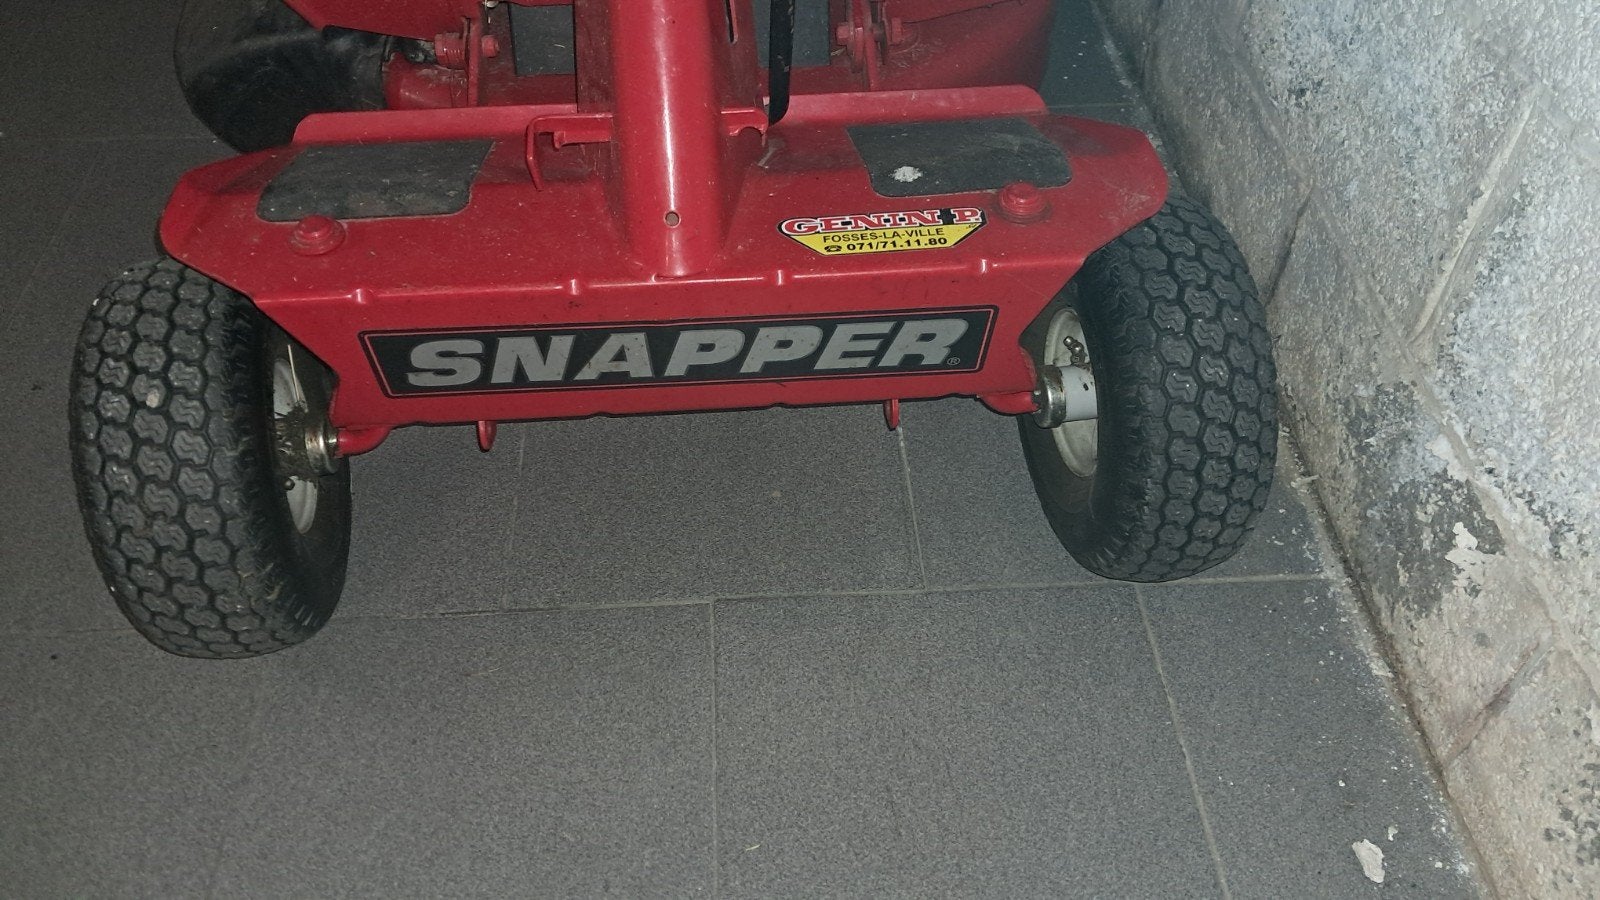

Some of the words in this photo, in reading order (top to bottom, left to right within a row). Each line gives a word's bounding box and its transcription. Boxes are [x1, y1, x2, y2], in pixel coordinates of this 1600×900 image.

[781, 209, 943, 236] GENIN
[823, 228, 945, 243] FOSSES-LA-VILLE
[846, 237, 947, 252] 071/71.11.80
[407, 318, 969, 387] SNAPPER
